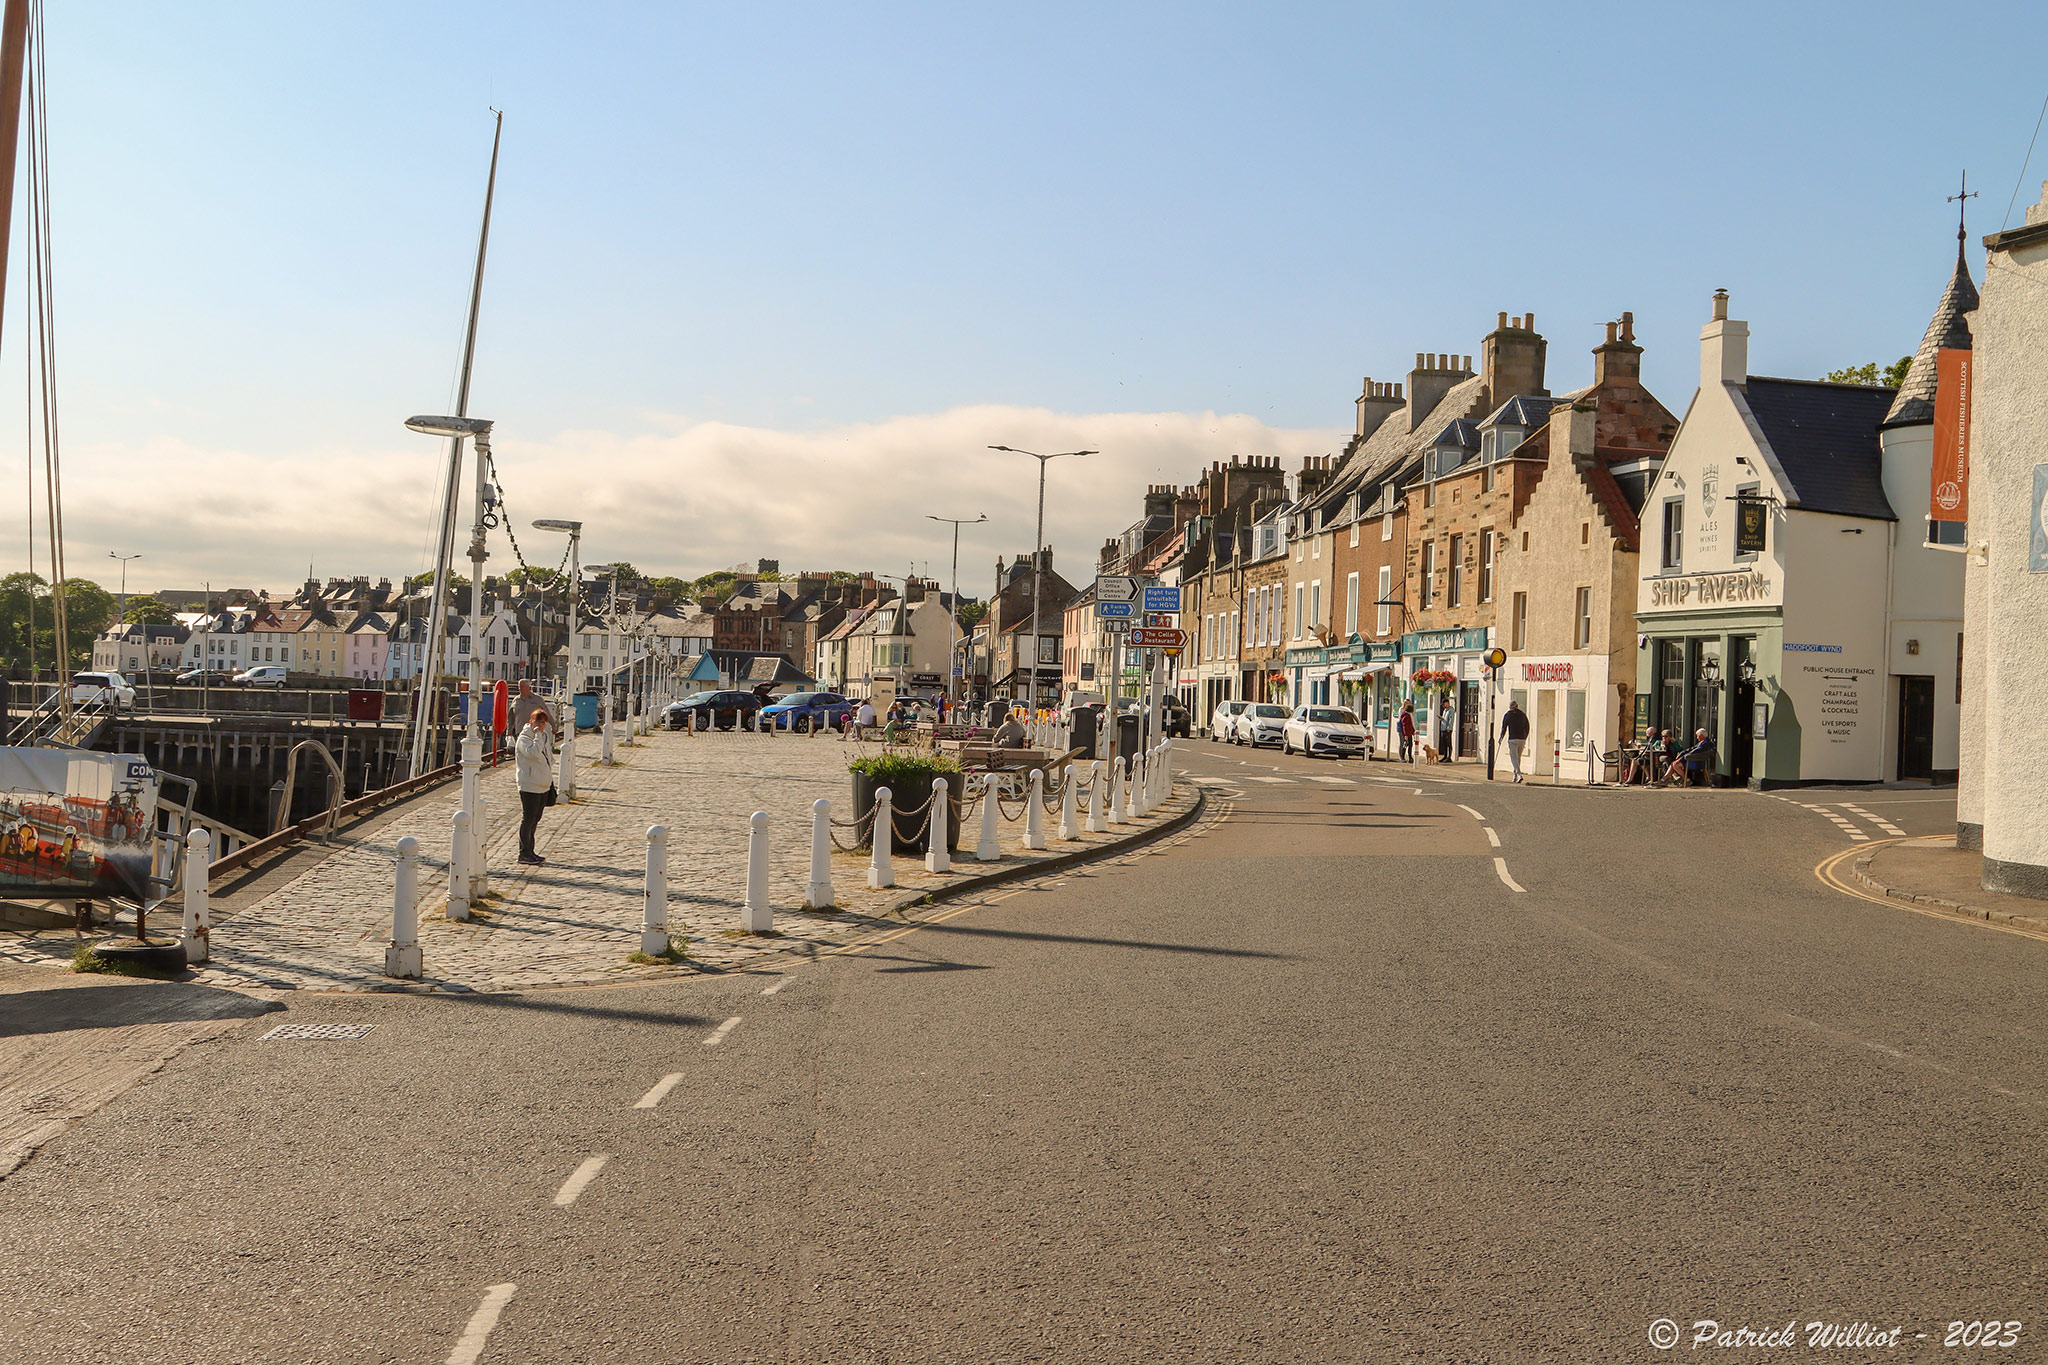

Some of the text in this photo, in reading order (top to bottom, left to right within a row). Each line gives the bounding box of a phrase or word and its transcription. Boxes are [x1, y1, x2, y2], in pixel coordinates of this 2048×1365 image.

[1957, 360, 1968, 483] SCOTTISH FISHERIES MUSEUM
[1700, 521, 1718, 532] ALES
[1699, 534, 1718, 543] WINES
[1699, 545, 1717, 553] SPIRITS
[1651, 570, 1765, 607] SHIP TAVERN
[1821, 645, 1842, 653] WYND
[1521, 662, 1574, 682] TURKISH BARBER
[1821, 698, 1858, 706] CHAMPAGNE
